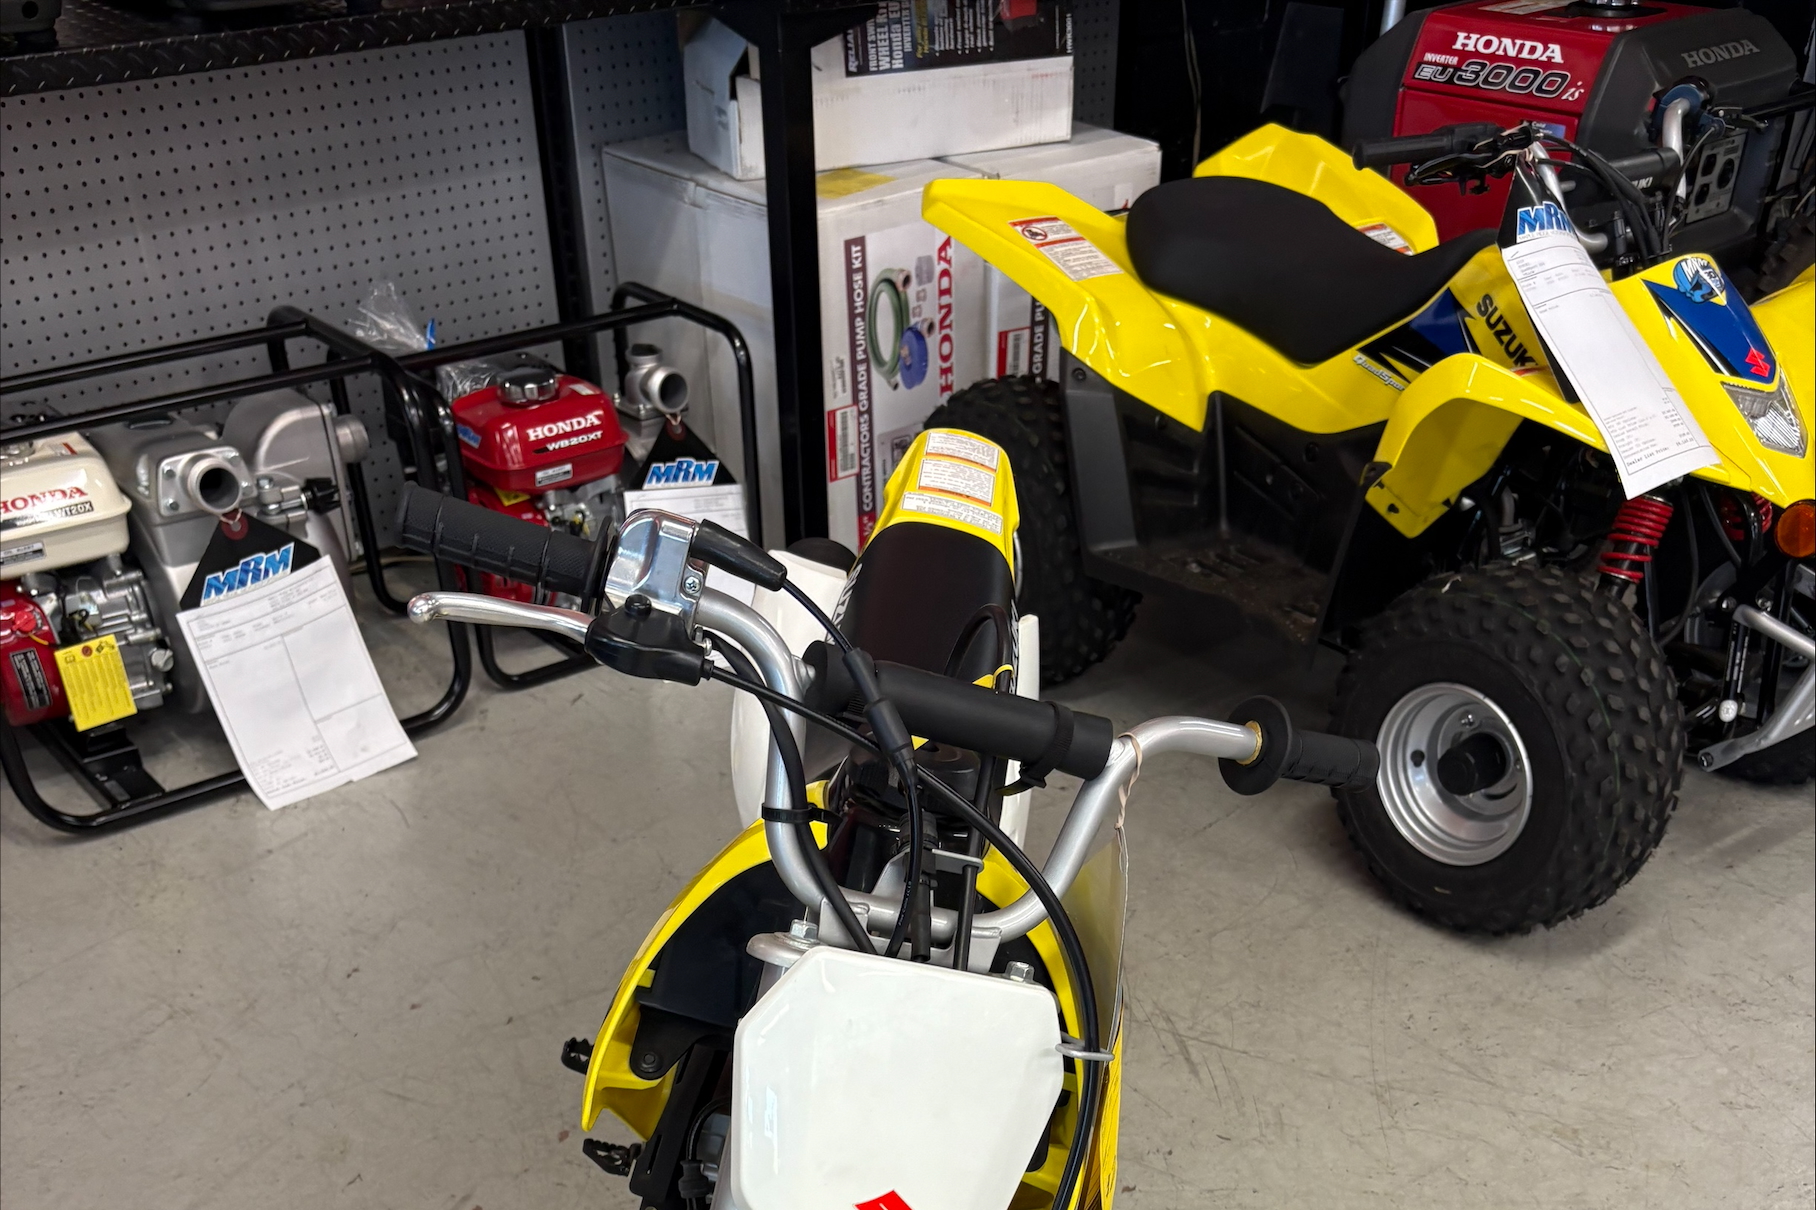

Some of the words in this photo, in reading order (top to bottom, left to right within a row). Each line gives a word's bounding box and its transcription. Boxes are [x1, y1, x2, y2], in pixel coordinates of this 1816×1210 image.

[847, 29, 859, 72] RELIA
[876, 25, 890, 70] WHEEL
[889, 23, 904, 68] Honda
[902, 9, 912, 52] INVERTER
[1452, 32, 1564, 64] HONDA
[867, 43, 878, 71] FRONT
[1423, 52, 1459, 65] INVERTER
[1681, 39, 1760, 68] HONDA
[1516, 200, 1575, 236] MRM
[851, 245, 863, 269] KIT
[852, 272, 865, 314] HOSE
[1034, 301, 1045, 322] PU
[937, 235, 954, 397] HONDA
[1476, 293, 1539, 368] SUZUK
[854, 317, 867, 361] PUMP
[1032, 324, 1045, 374] GRADE
[856, 362, 869, 411] GRADE
[526, 410, 605, 441] HONDA
[546, 431, 603, 451] WB20XT
[645, 458, 718, 485] MRM
[860, 413, 873, 512] CONTRACTORS
[202, 543, 294, 601] MRM
